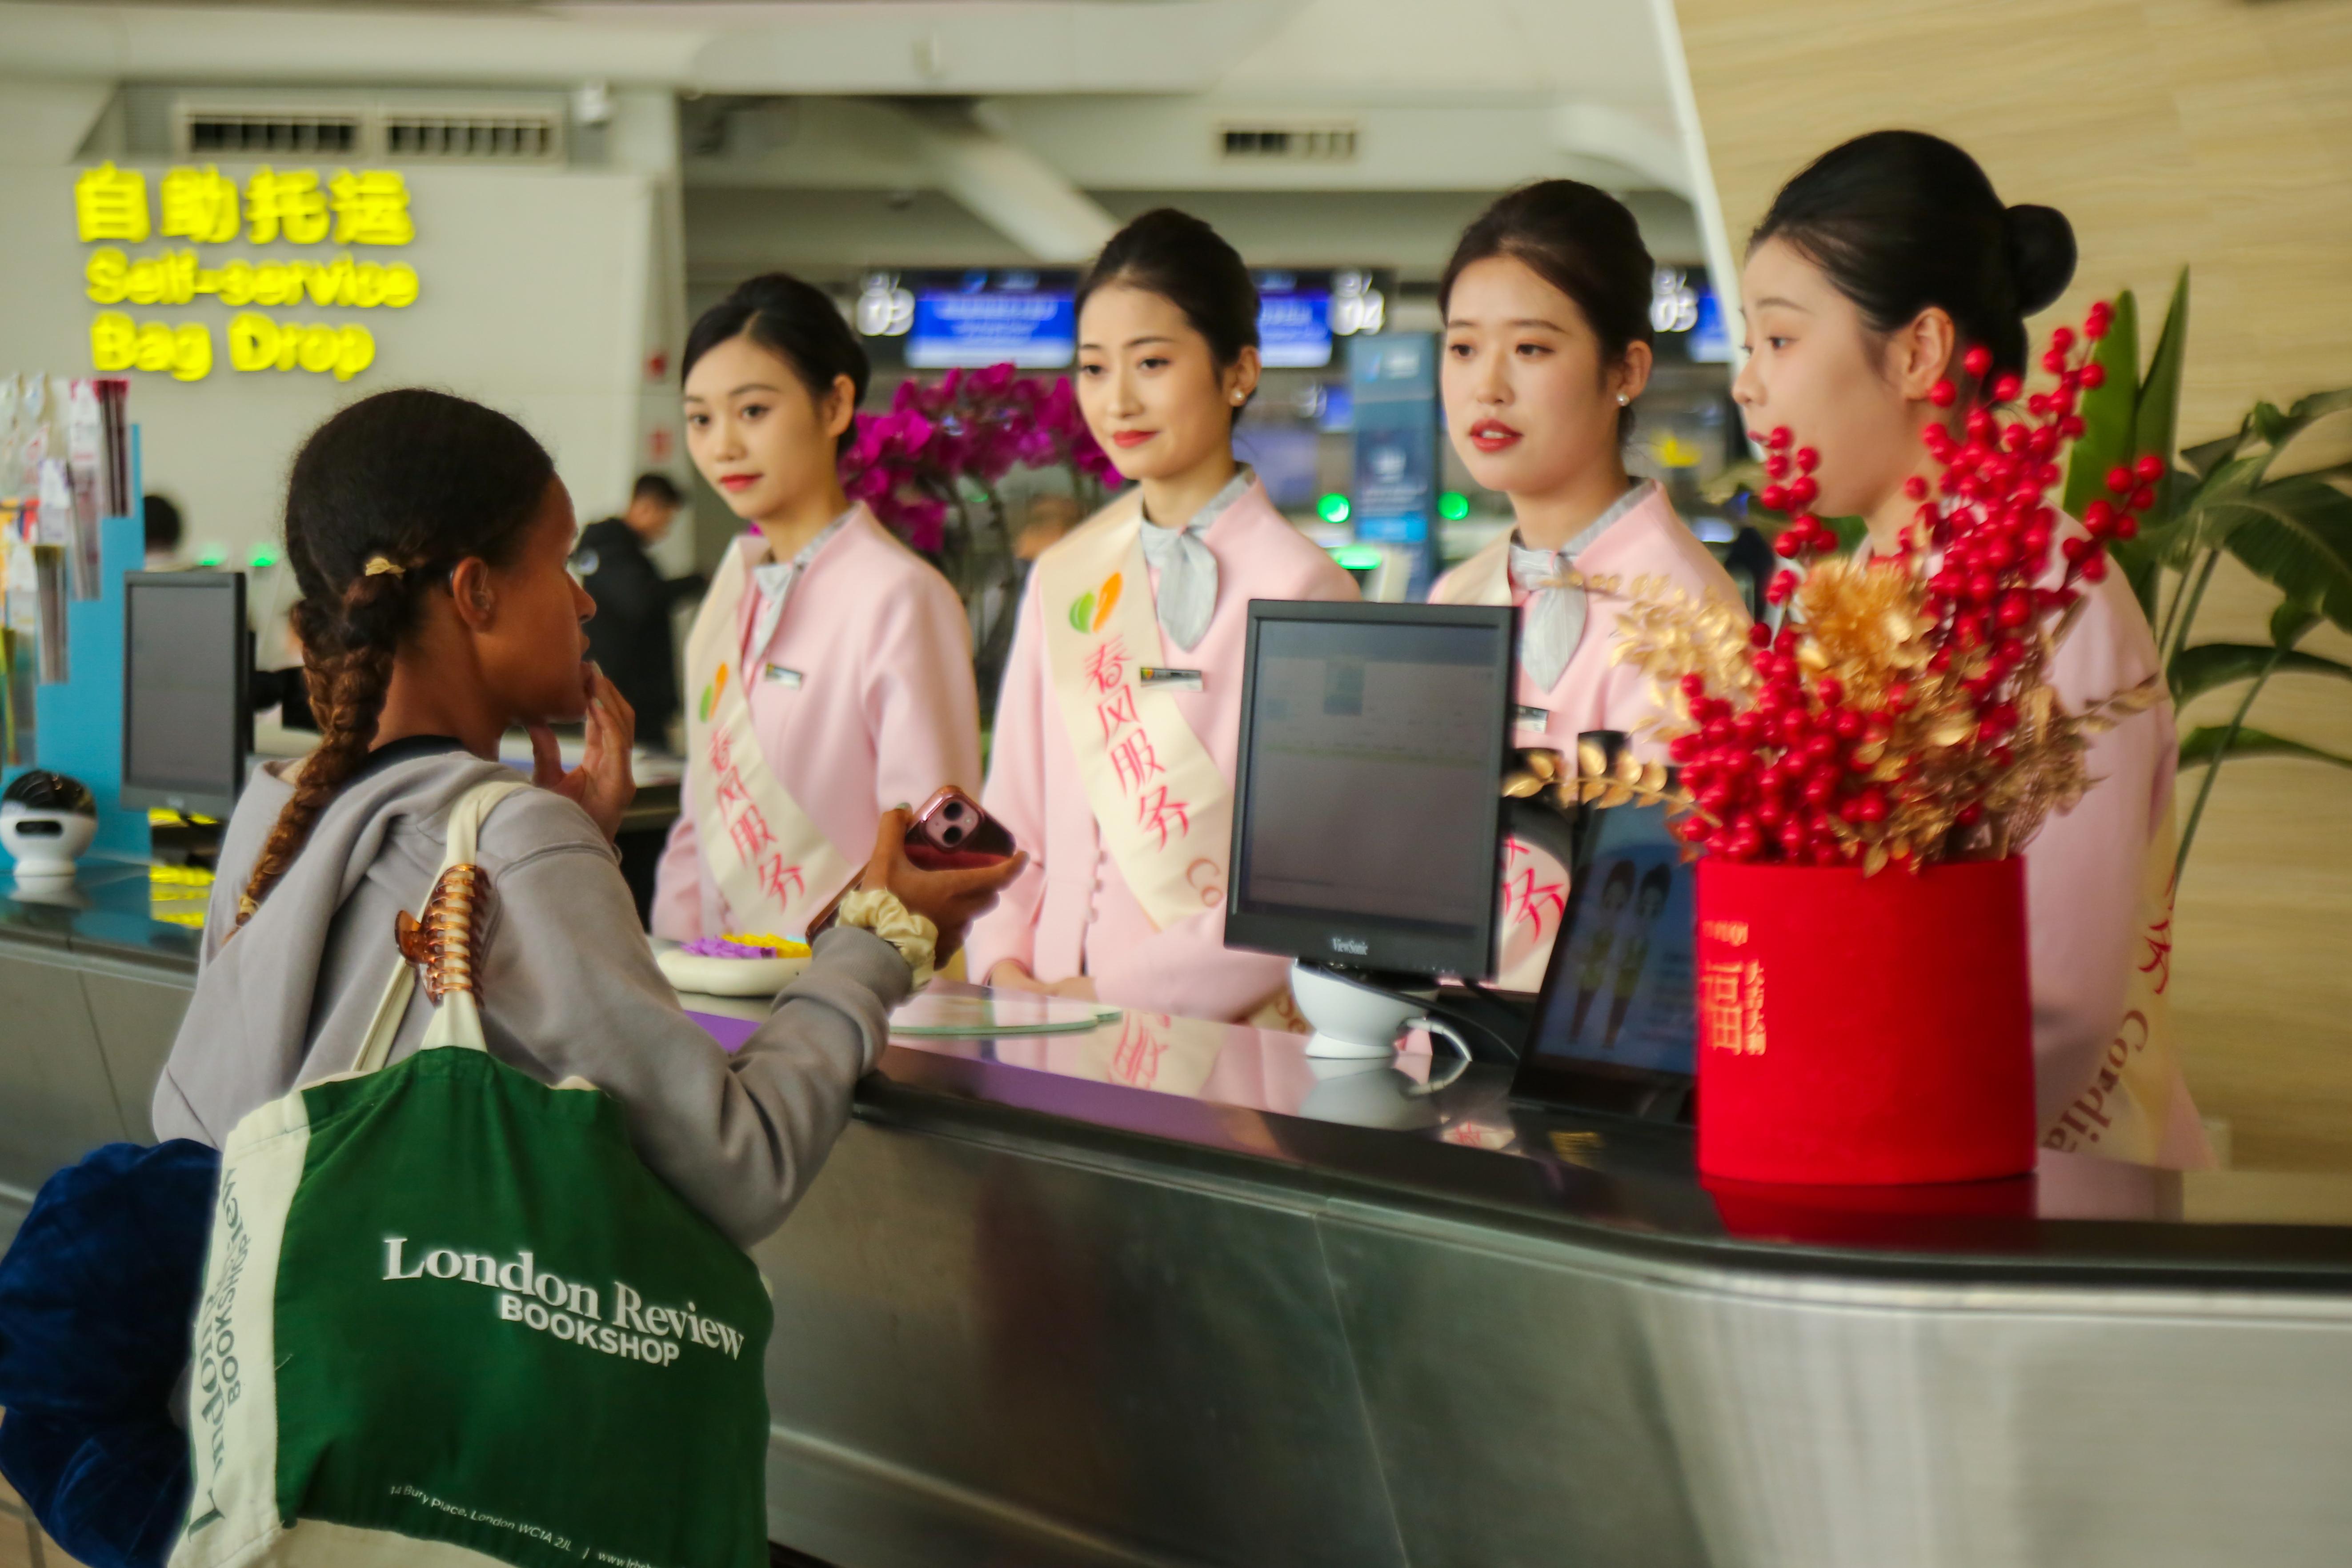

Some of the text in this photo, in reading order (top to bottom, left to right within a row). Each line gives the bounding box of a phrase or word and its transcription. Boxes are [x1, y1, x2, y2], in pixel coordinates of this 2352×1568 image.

[75, 160, 415, 245] 自助托运
[86, 246, 419, 308] Self-service
[92, 310, 376, 381] Bag Drop
[1083, 637, 1190, 853] 春风服务
[710, 726, 805, 915] 春风服务
[1503, 836, 1565, 942] 务
[216, 1234, 251, 1408] BOOKSHOP
[383, 1238, 745, 1360] London Review
[501, 1294, 680, 1367] BOOKSHOP
[404, 1485, 429, 1504] Bury
[470, 1510, 515, 1530] London
[518, 1524, 552, 1543] WC1A
[553, 1536, 572, 1552] 2JL
